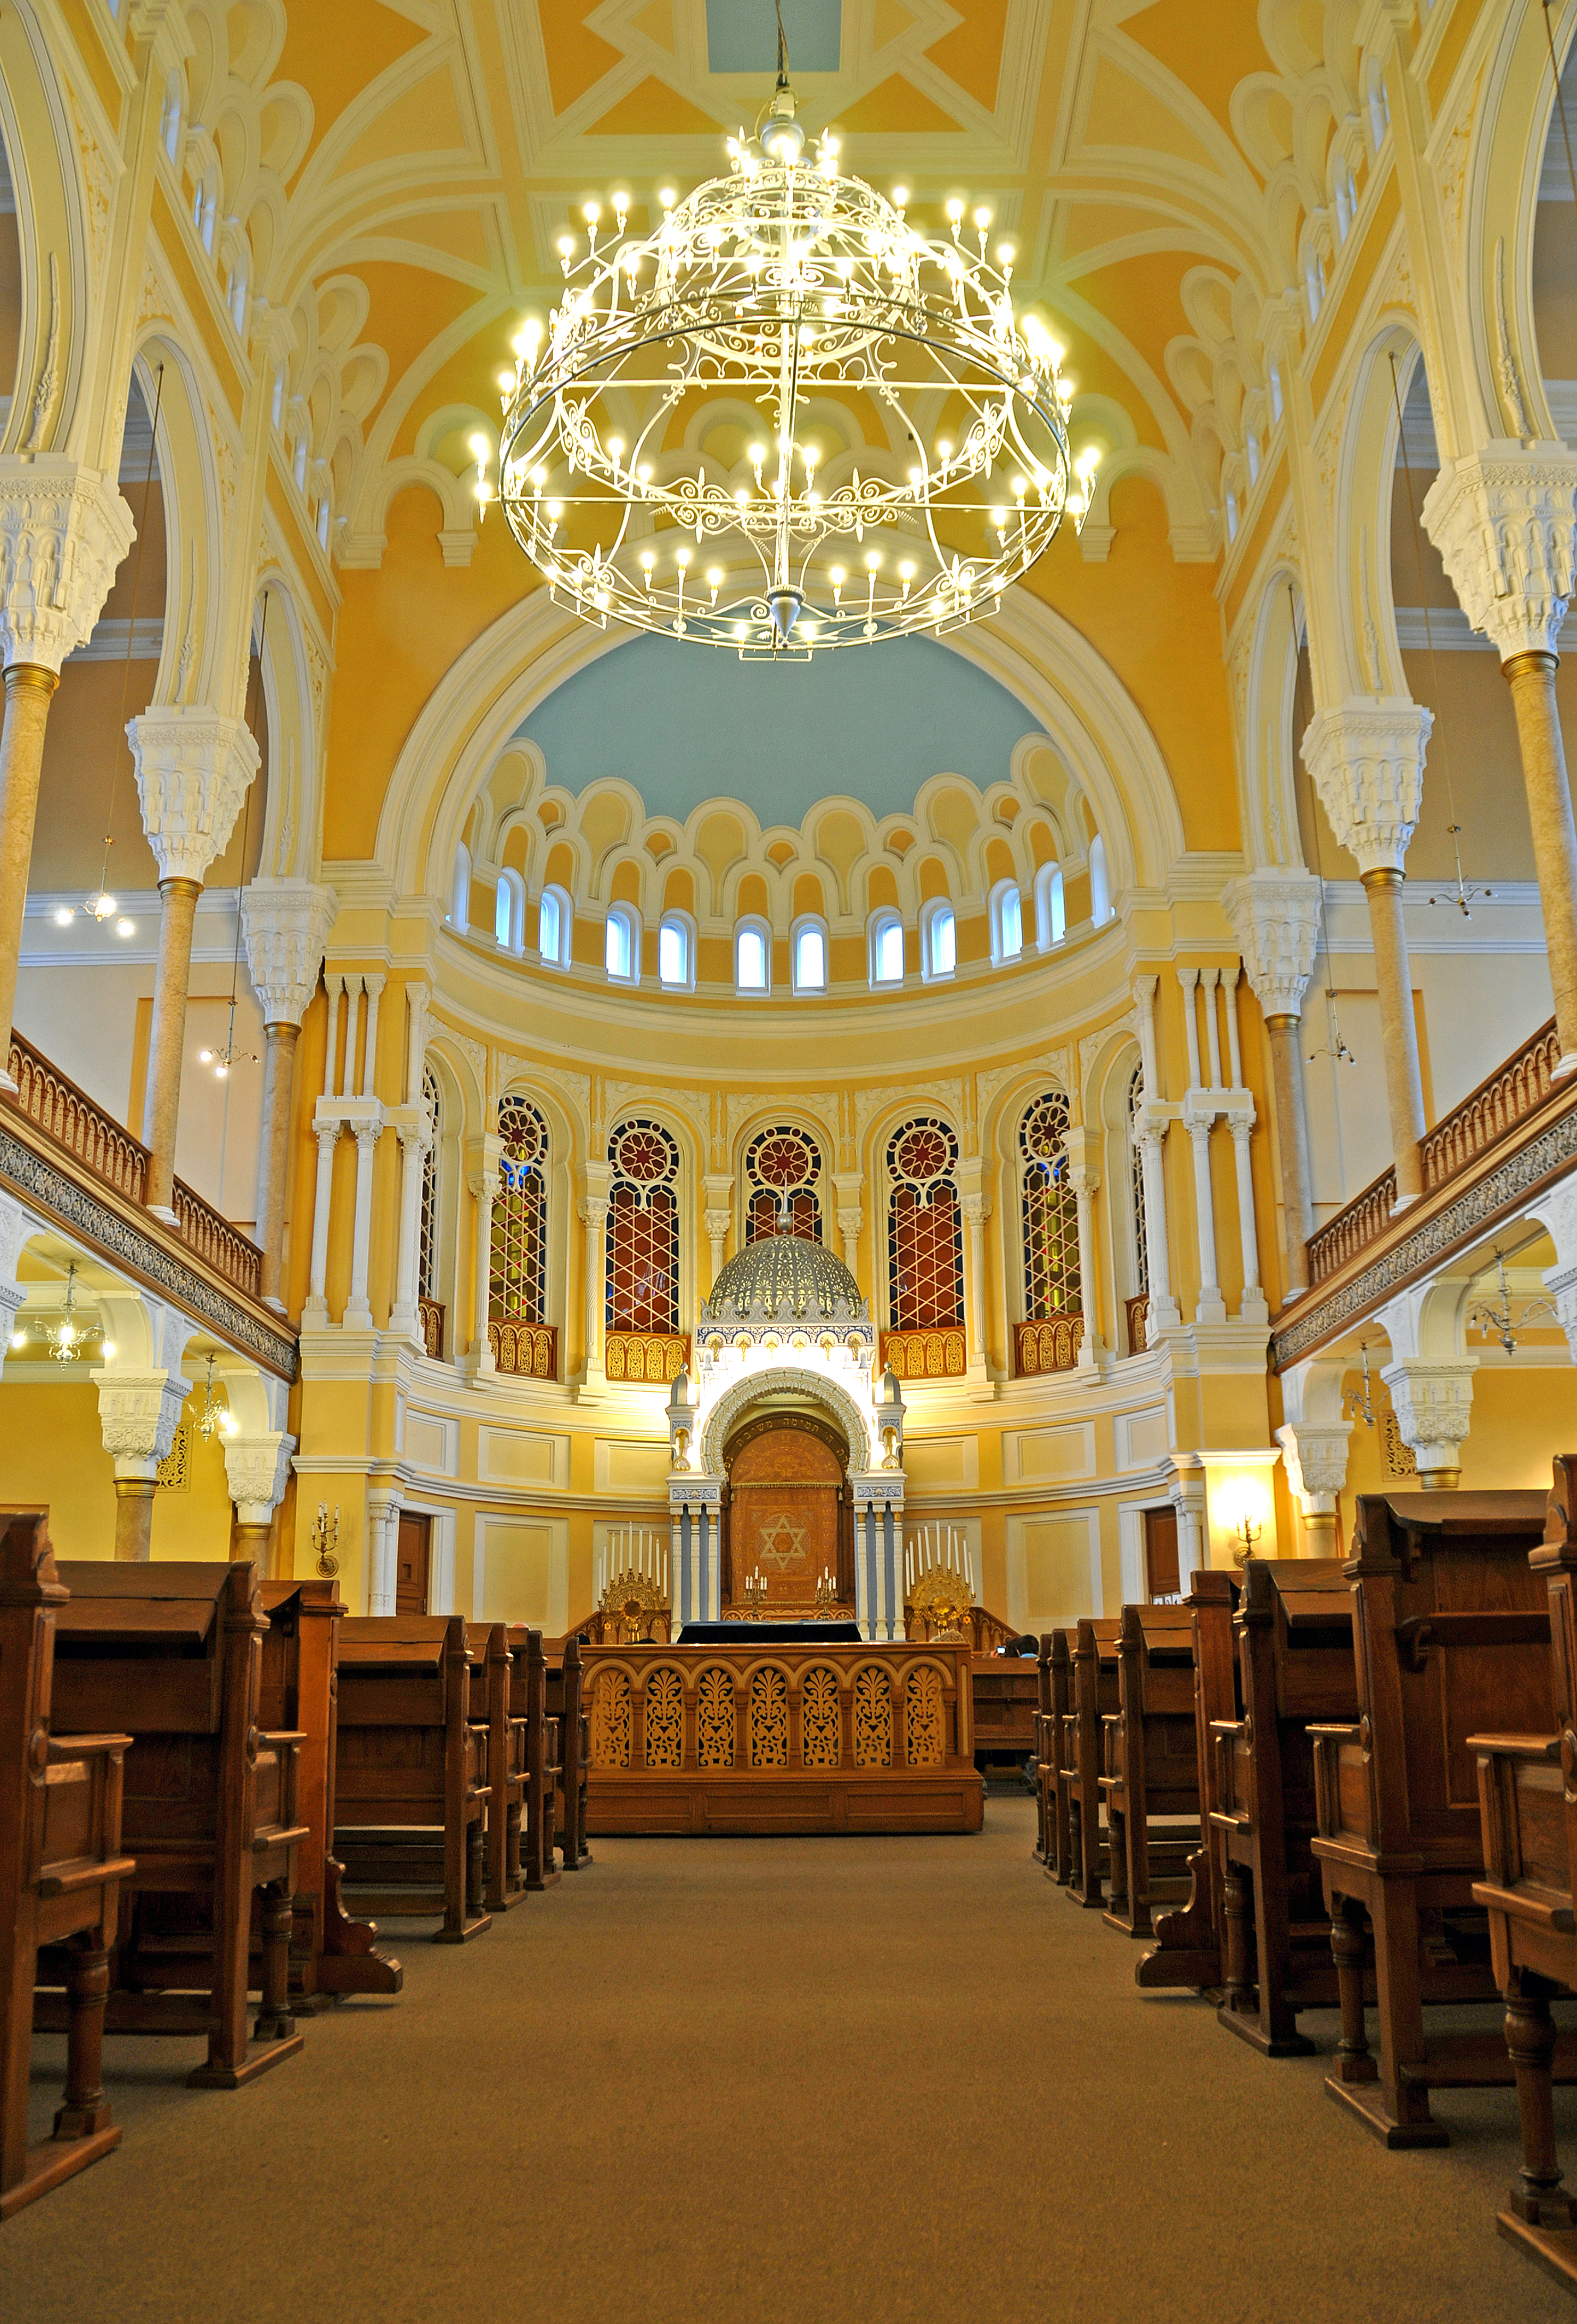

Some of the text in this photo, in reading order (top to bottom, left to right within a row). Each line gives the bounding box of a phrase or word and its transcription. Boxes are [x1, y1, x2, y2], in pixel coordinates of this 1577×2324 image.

[736, 1420, 773, 1447] משיבת
[783, 1418, 819, 1433] תמימה
[724, 1456, 733, 1475] נפ
